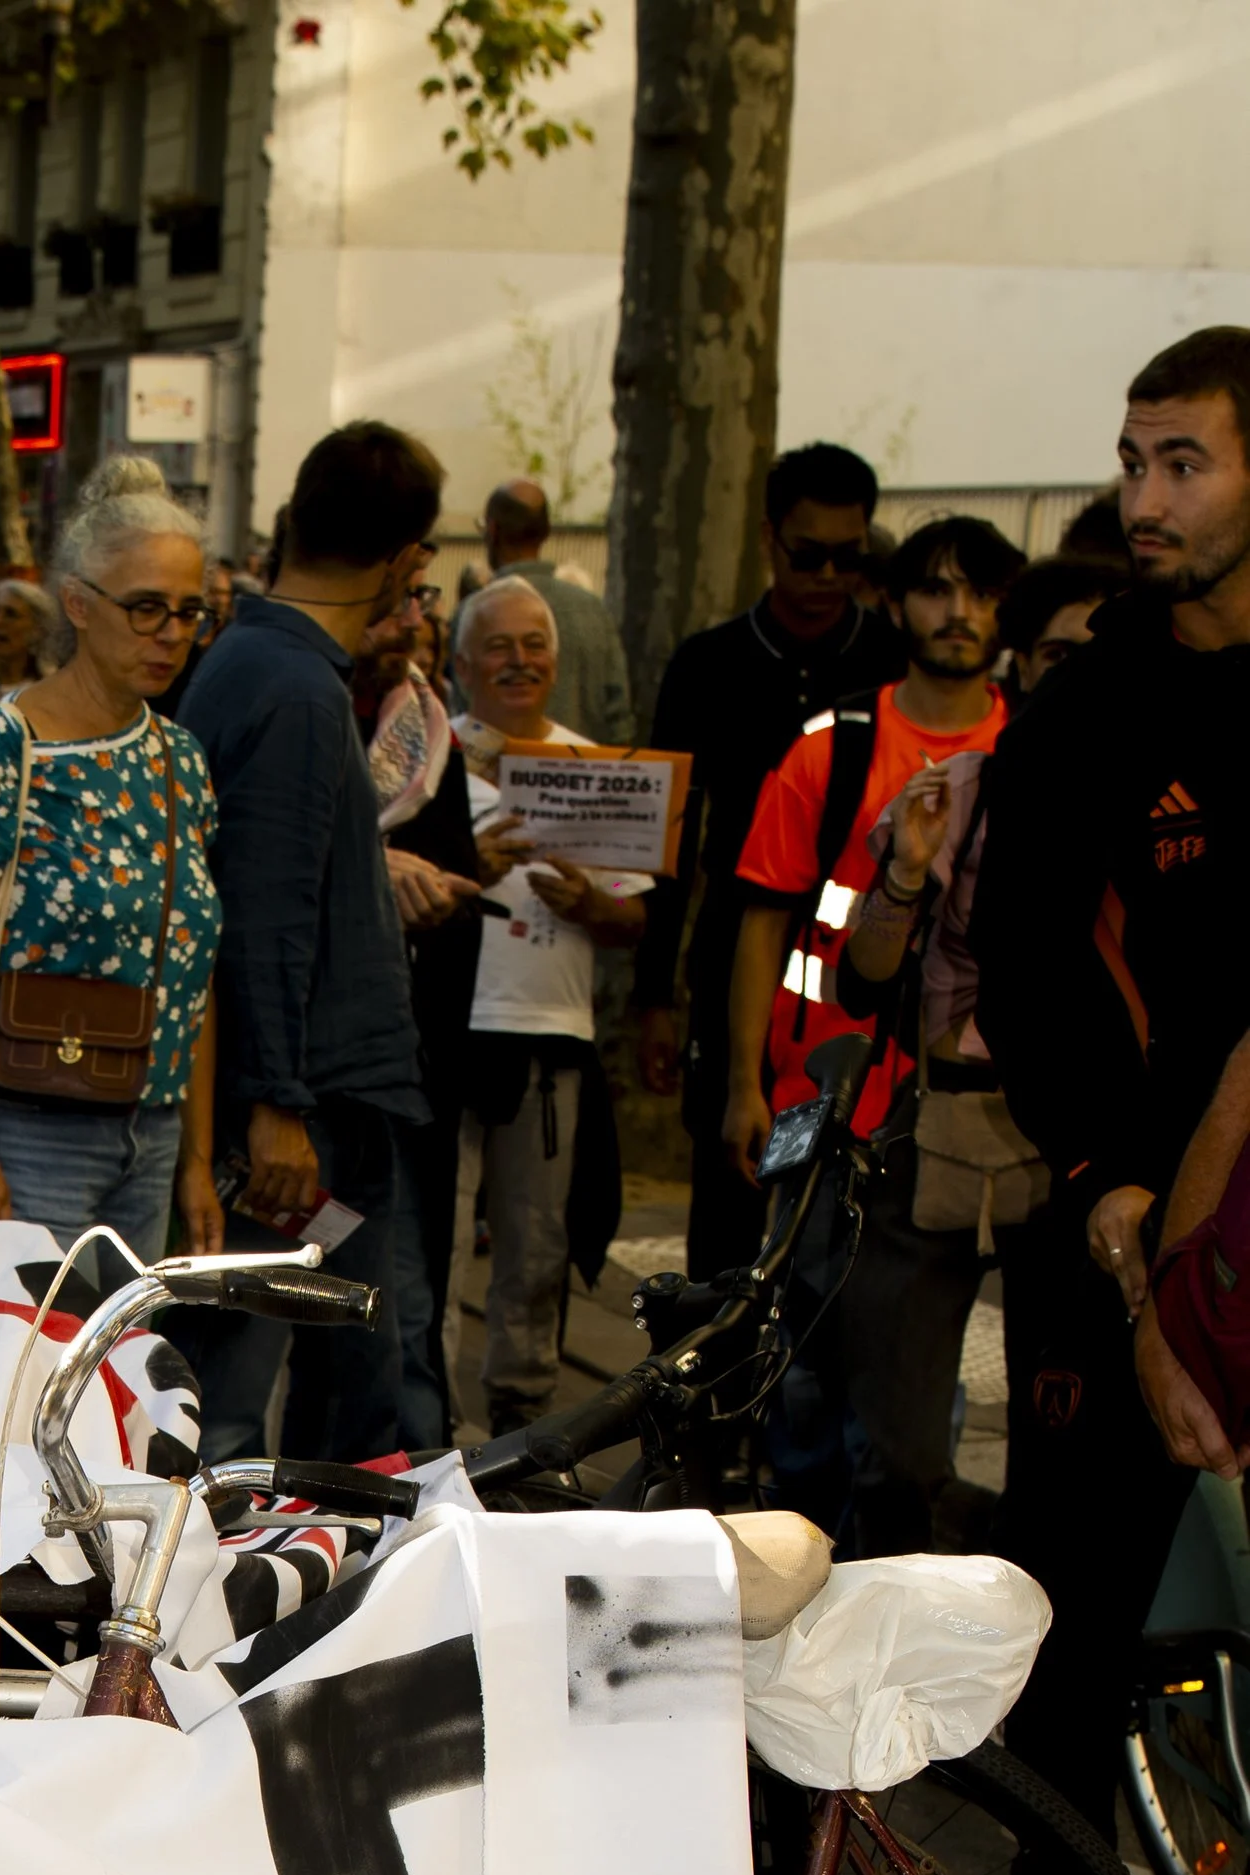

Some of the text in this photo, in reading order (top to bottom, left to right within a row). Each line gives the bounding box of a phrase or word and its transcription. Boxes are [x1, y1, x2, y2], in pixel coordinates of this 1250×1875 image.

[510, 771, 593, 791] BUDGET
[597, 775, 651, 794] 2026
[539, 793, 630, 808] Pas question
[530, 808, 577, 822] passer
[1154, 836, 1207, 874] JEFE
